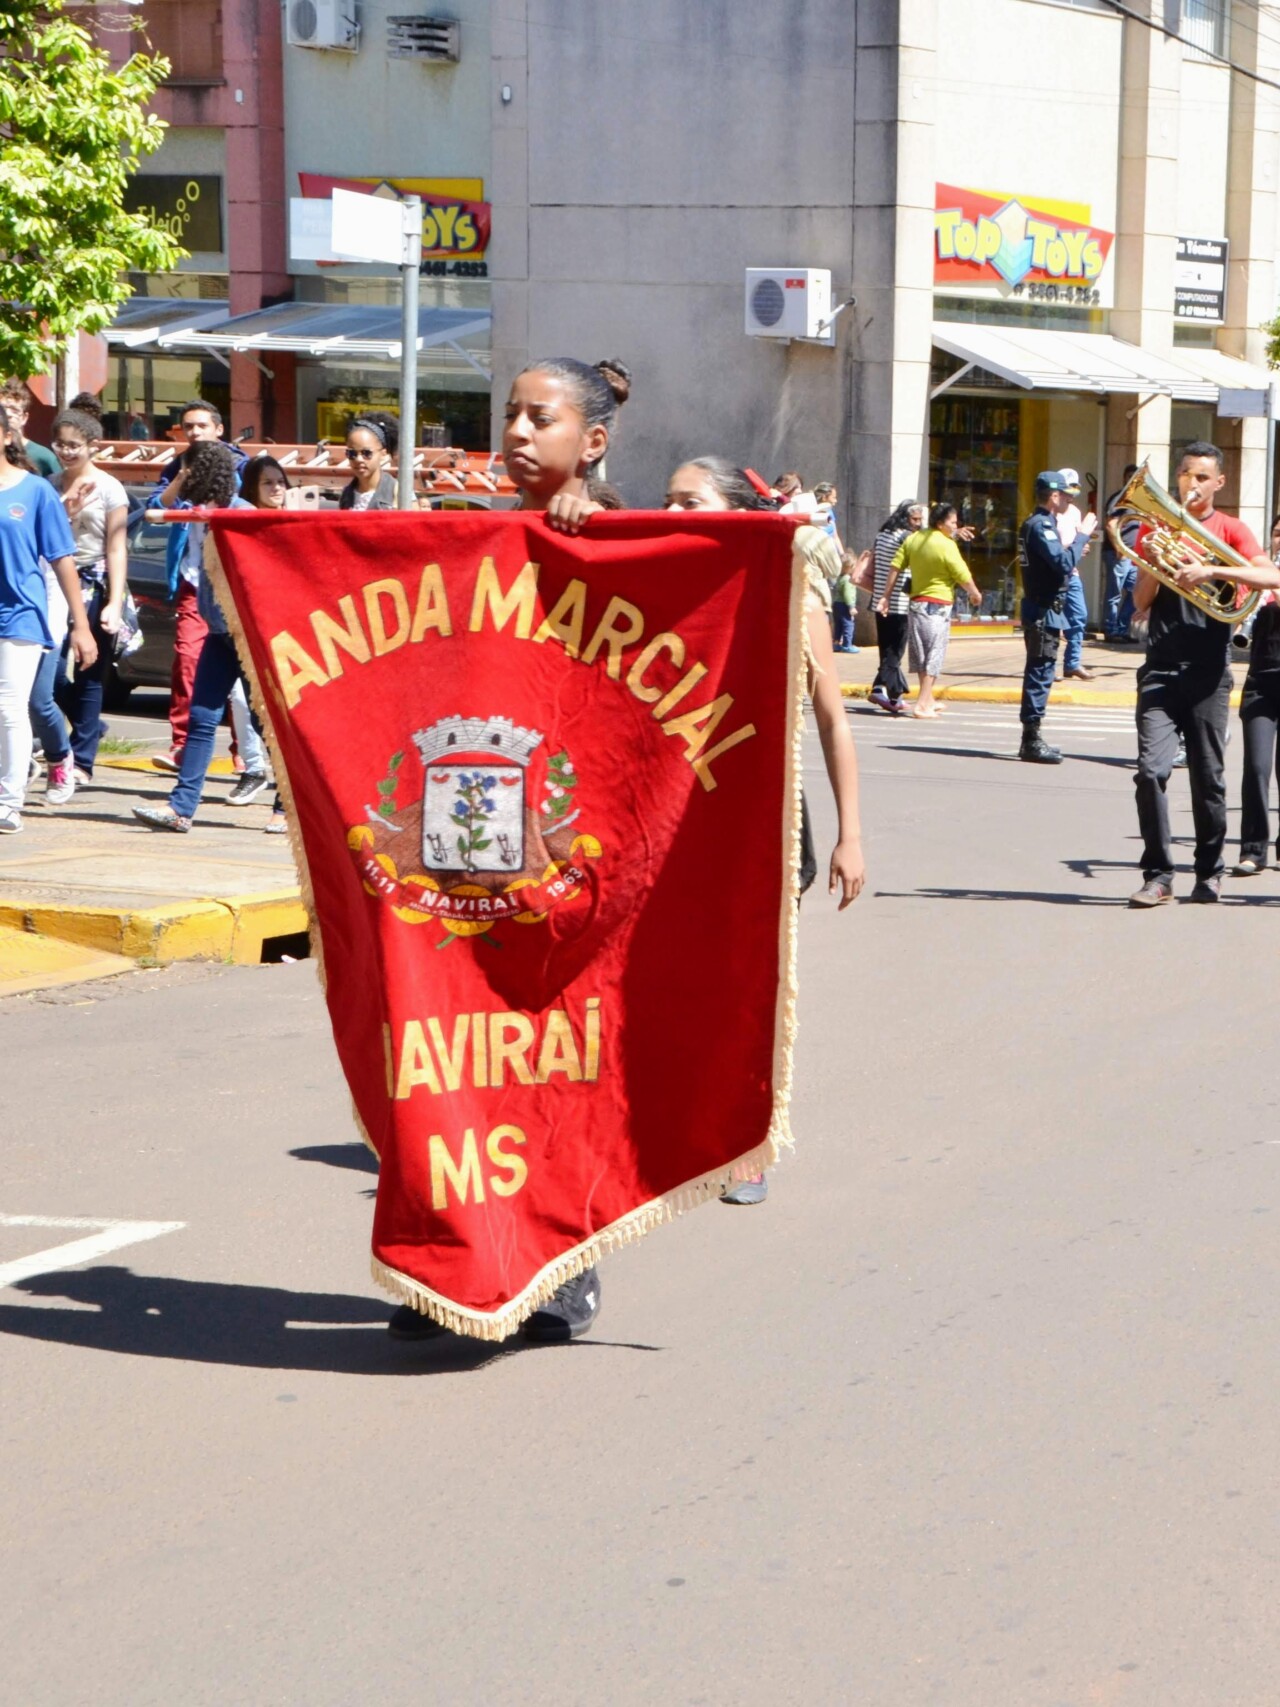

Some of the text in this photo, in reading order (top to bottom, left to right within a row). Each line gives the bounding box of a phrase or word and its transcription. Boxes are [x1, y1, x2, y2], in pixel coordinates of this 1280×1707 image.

[264, 556, 756, 792] ANDA MARCIAL
[546, 867, 583, 897] 1963
[382, 997, 600, 1100] AVIRAÍ
[428, 1124, 528, 1210] MS
